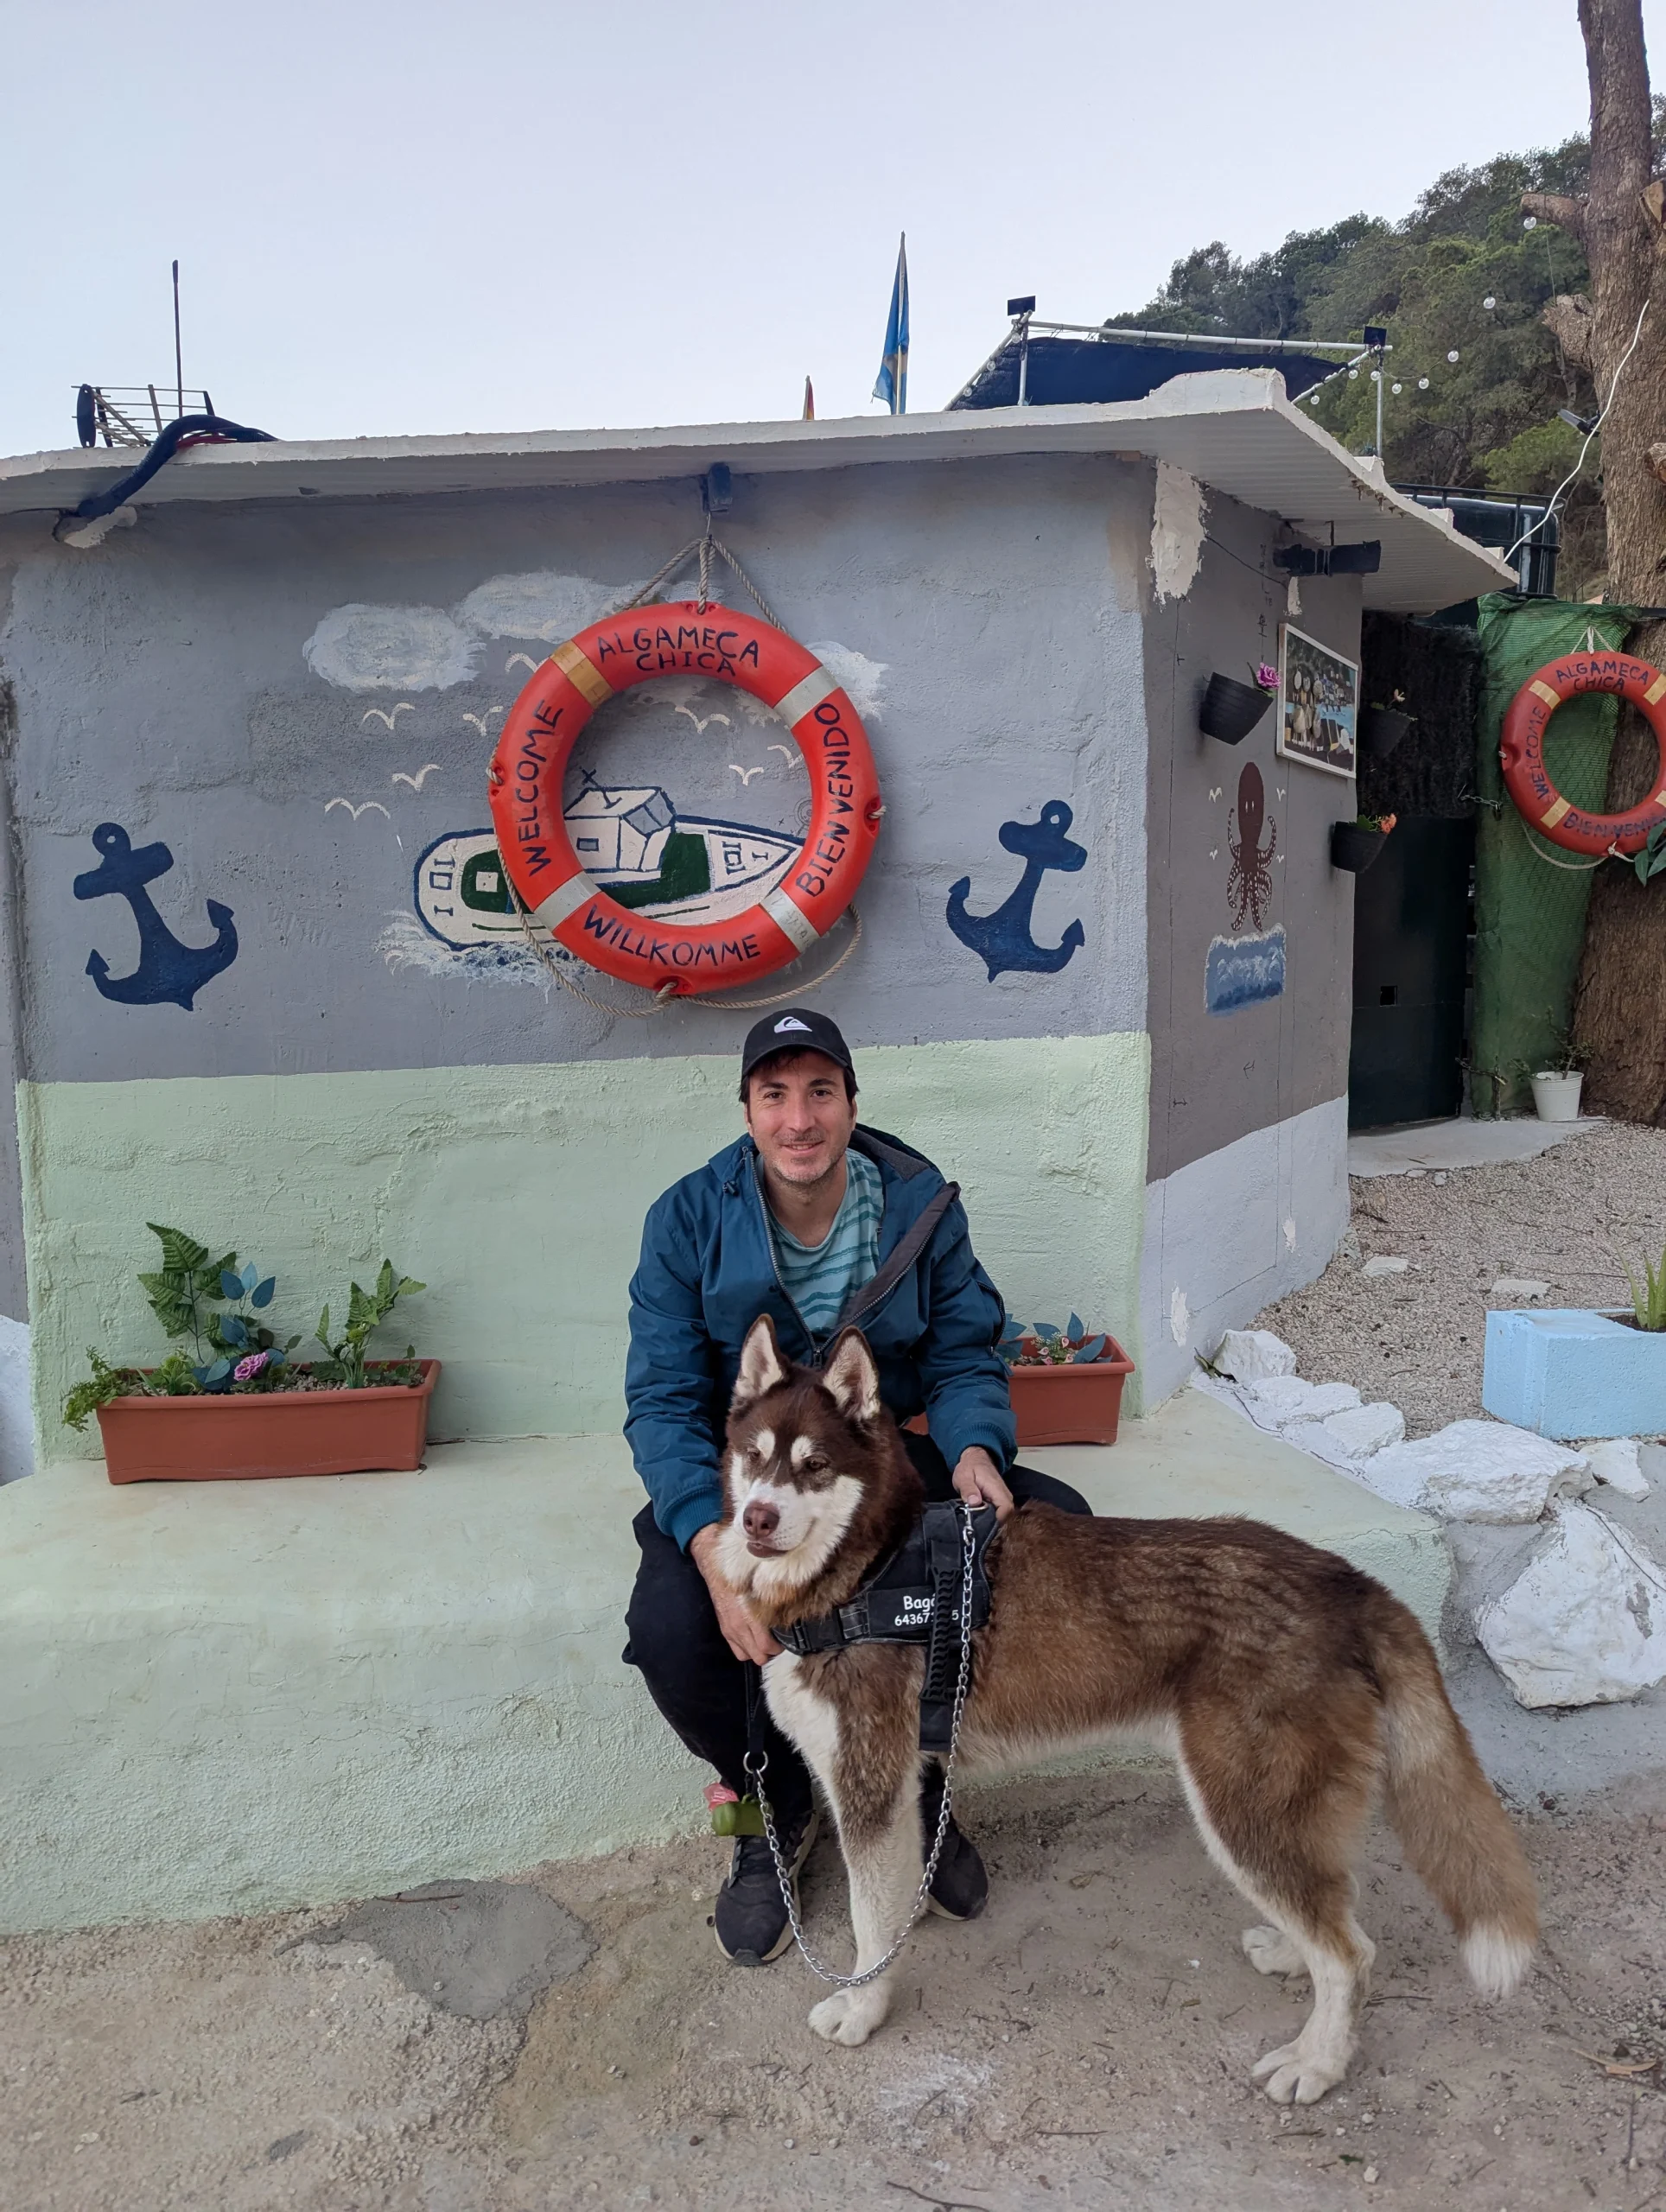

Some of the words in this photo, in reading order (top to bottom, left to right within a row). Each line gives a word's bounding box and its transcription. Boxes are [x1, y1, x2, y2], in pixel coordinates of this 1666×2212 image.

[597, 626, 759, 668] ALGAMECA
[636, 653, 736, 677] CHICA
[1556, 660, 1649, 685] ALGAMECA
[1574, 676, 1625, 690] CHICA
[1525, 705, 1549, 800] WELCOME
[516, 699, 563, 876] WELCOME
[583, 905, 760, 966] WILLKOMME
